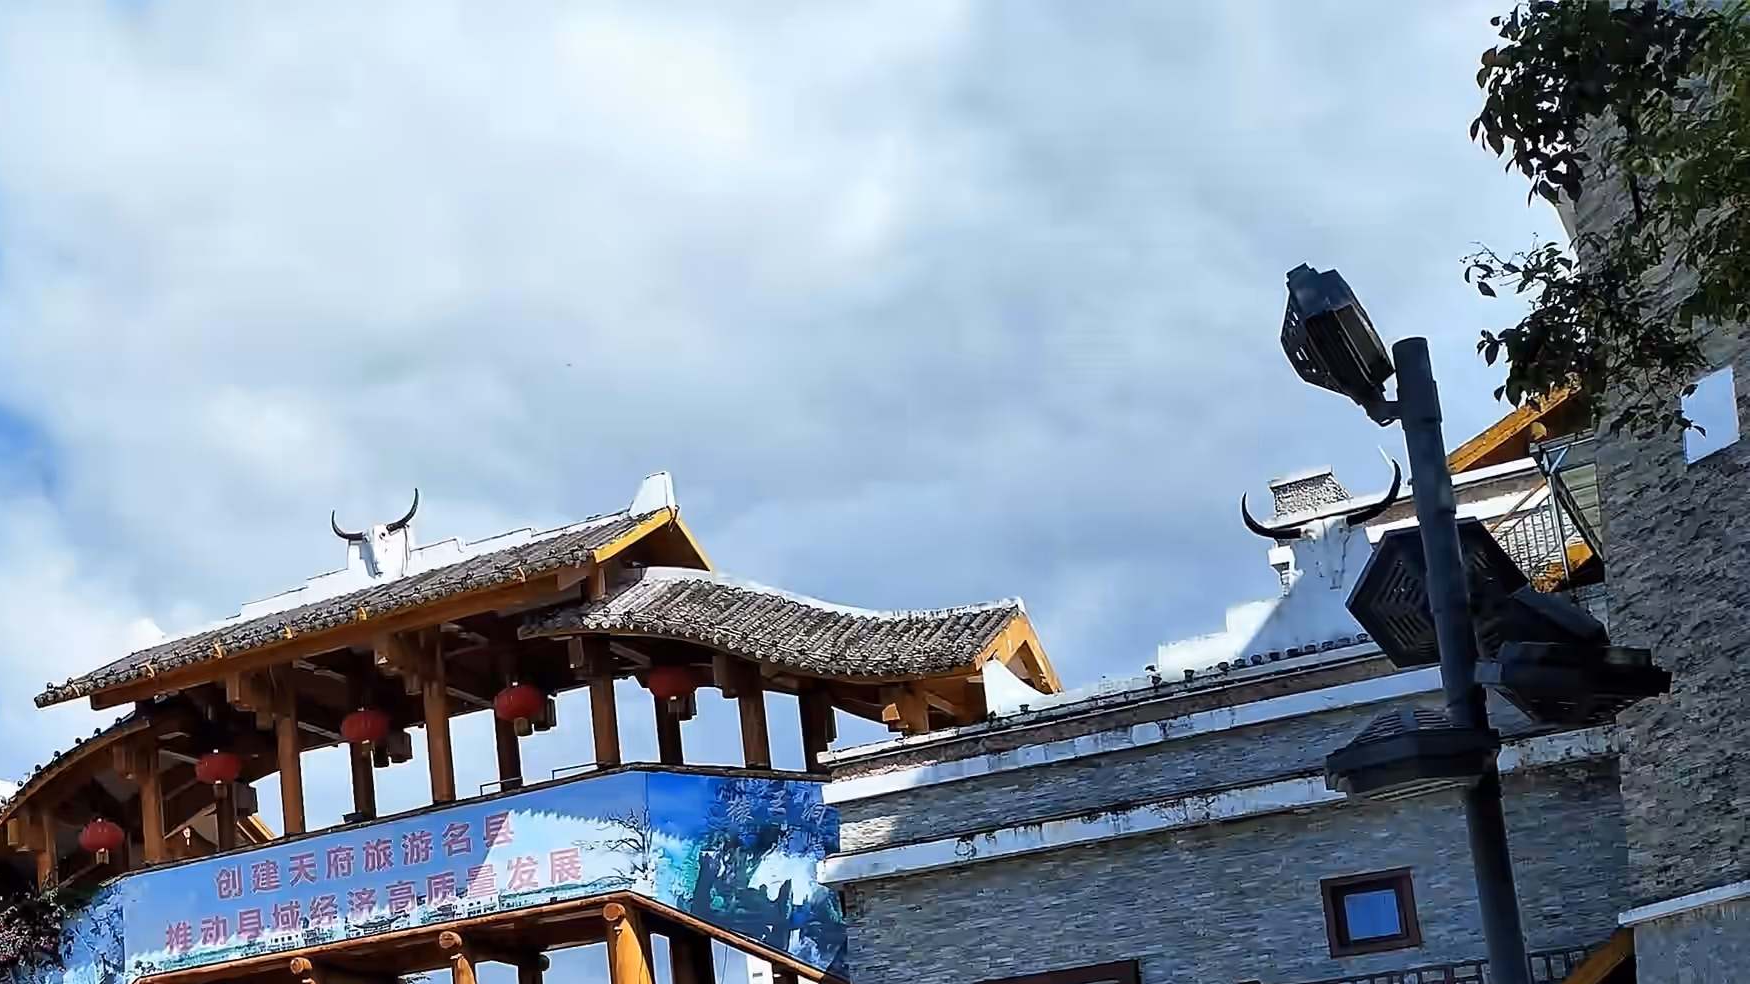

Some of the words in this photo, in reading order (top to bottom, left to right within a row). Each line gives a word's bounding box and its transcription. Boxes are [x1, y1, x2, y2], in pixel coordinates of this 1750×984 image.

[165, 848, 583, 953] 推动县域经济高质量发展
[216, 811, 516, 900] 创建天府旅游名县
